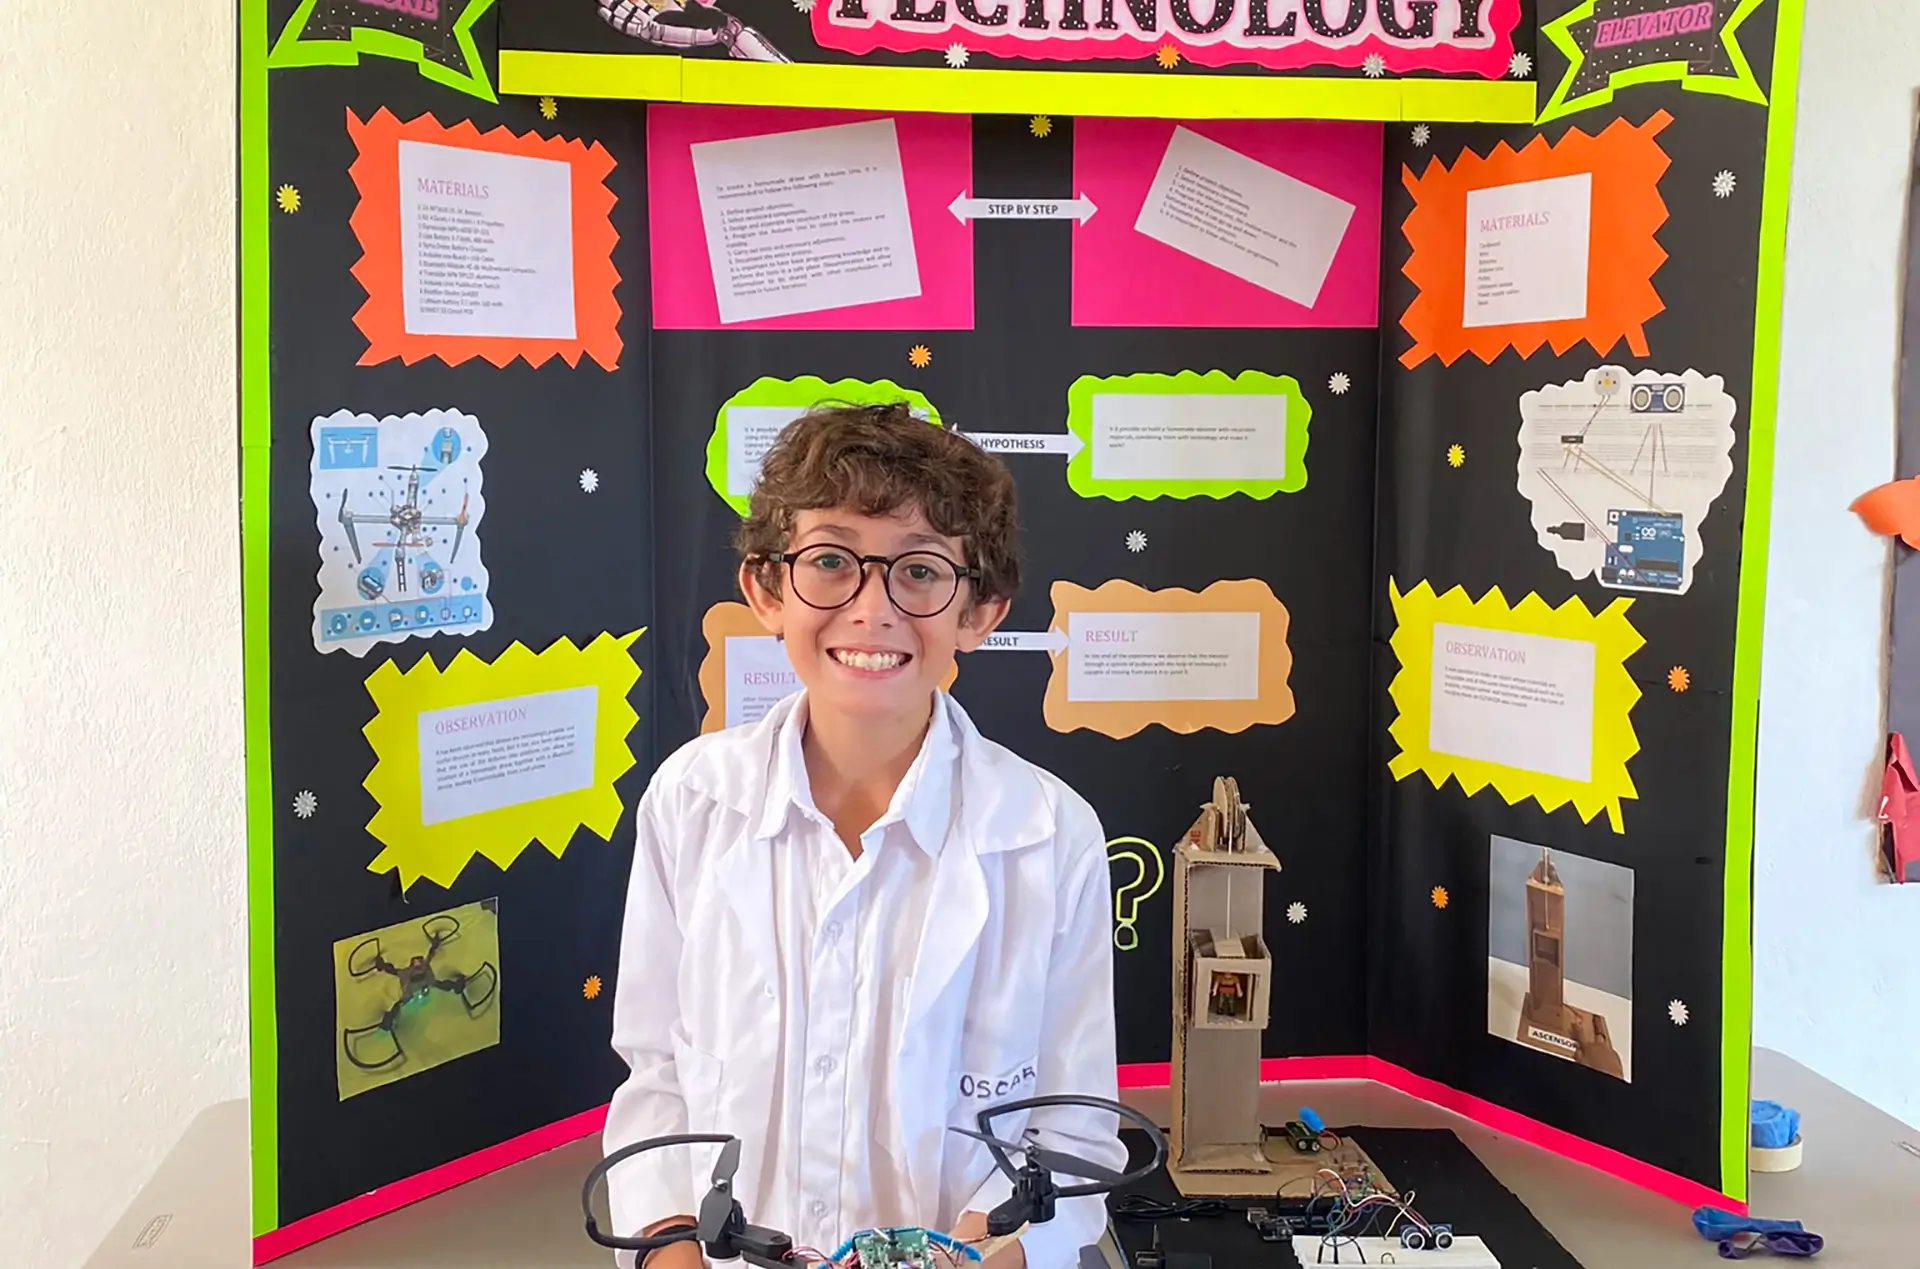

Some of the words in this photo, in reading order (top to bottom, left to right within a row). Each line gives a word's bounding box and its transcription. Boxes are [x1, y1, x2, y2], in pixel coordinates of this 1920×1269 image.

[1598, 5, 1710, 43] ELEVATOR
[417, 177, 489, 199] MATERIALS
[988, 204, 1014, 215] STEP
[1016, 204, 1030, 214] BY
[1033, 204, 1058, 215] STEP
[1480, 212, 1550, 231] MATERIALS
[980, 439, 1045, 449] HYPOTHESIS
[982, 637, 1019, 646] ESULT
[1085, 630, 1138, 643] RESULT
[1446, 640, 1526, 664] OBSERVATION
[744, 672, 796, 685] RESULT
[435, 707, 527, 735] OBSERVATION
[960, 1066, 1036, 1099] OSCAR
